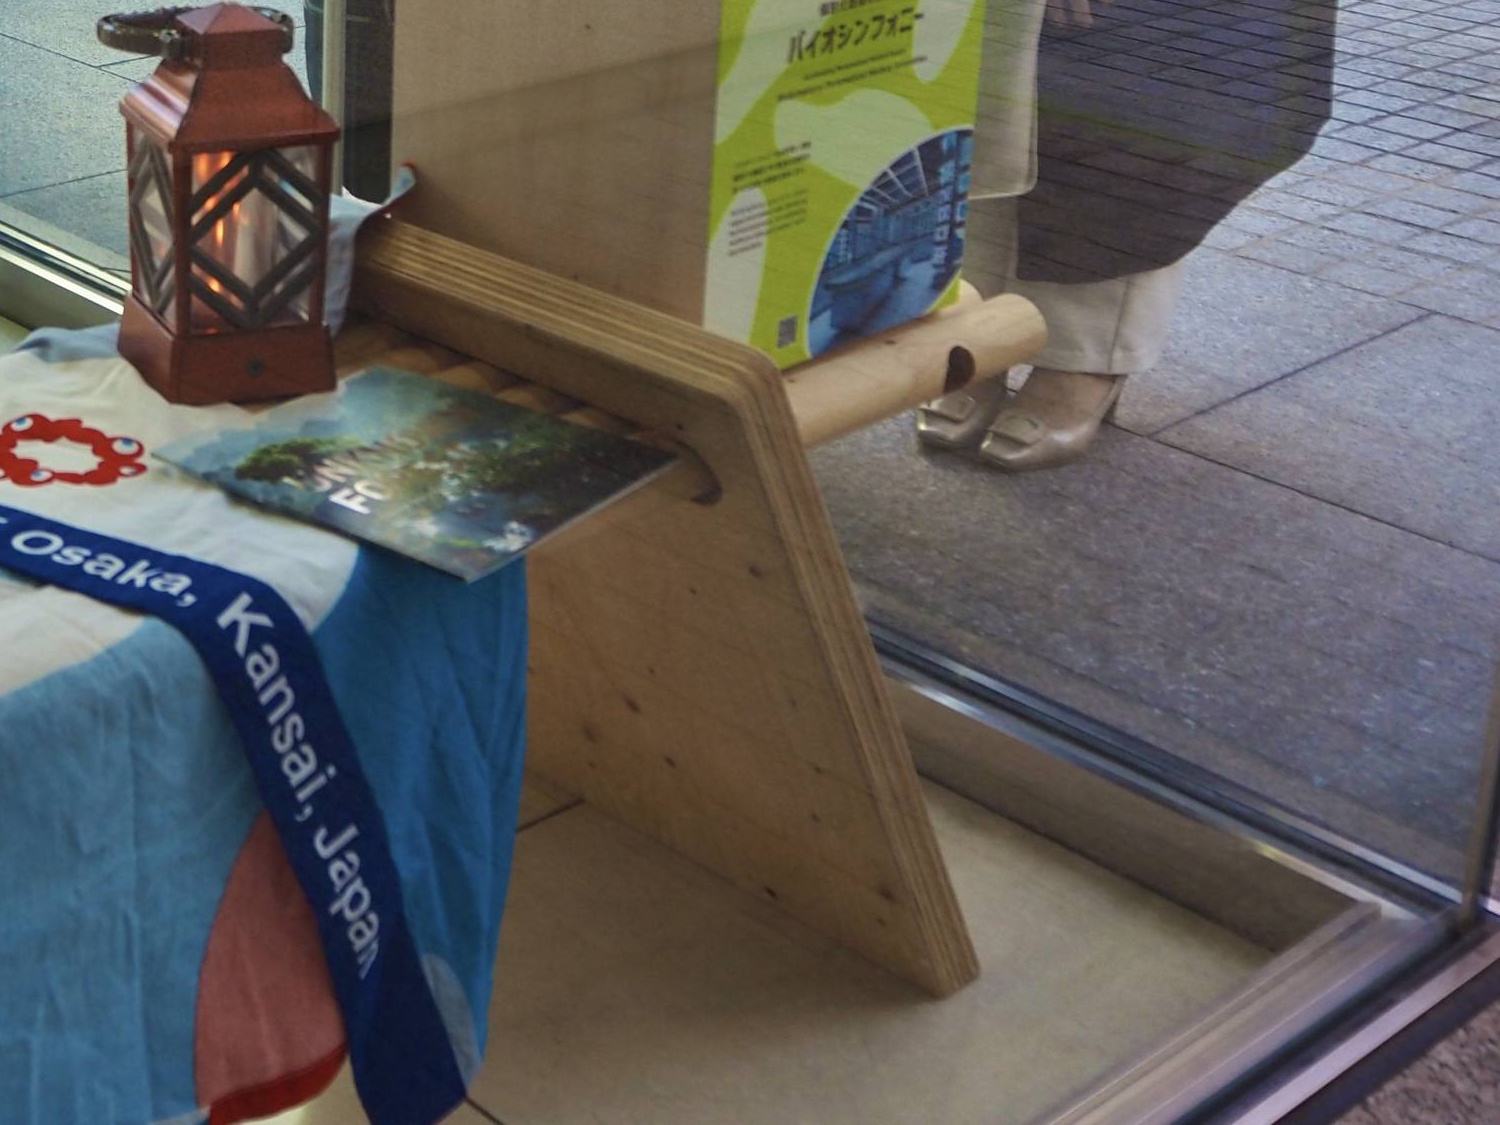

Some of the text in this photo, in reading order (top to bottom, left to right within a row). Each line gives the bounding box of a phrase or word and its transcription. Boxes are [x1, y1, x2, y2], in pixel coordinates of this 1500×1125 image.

[787, 6, 925, 64] バイオシンフォニー
[11, 529, 198, 608] Osaka,
[215, 591, 337, 822] Kansai,
